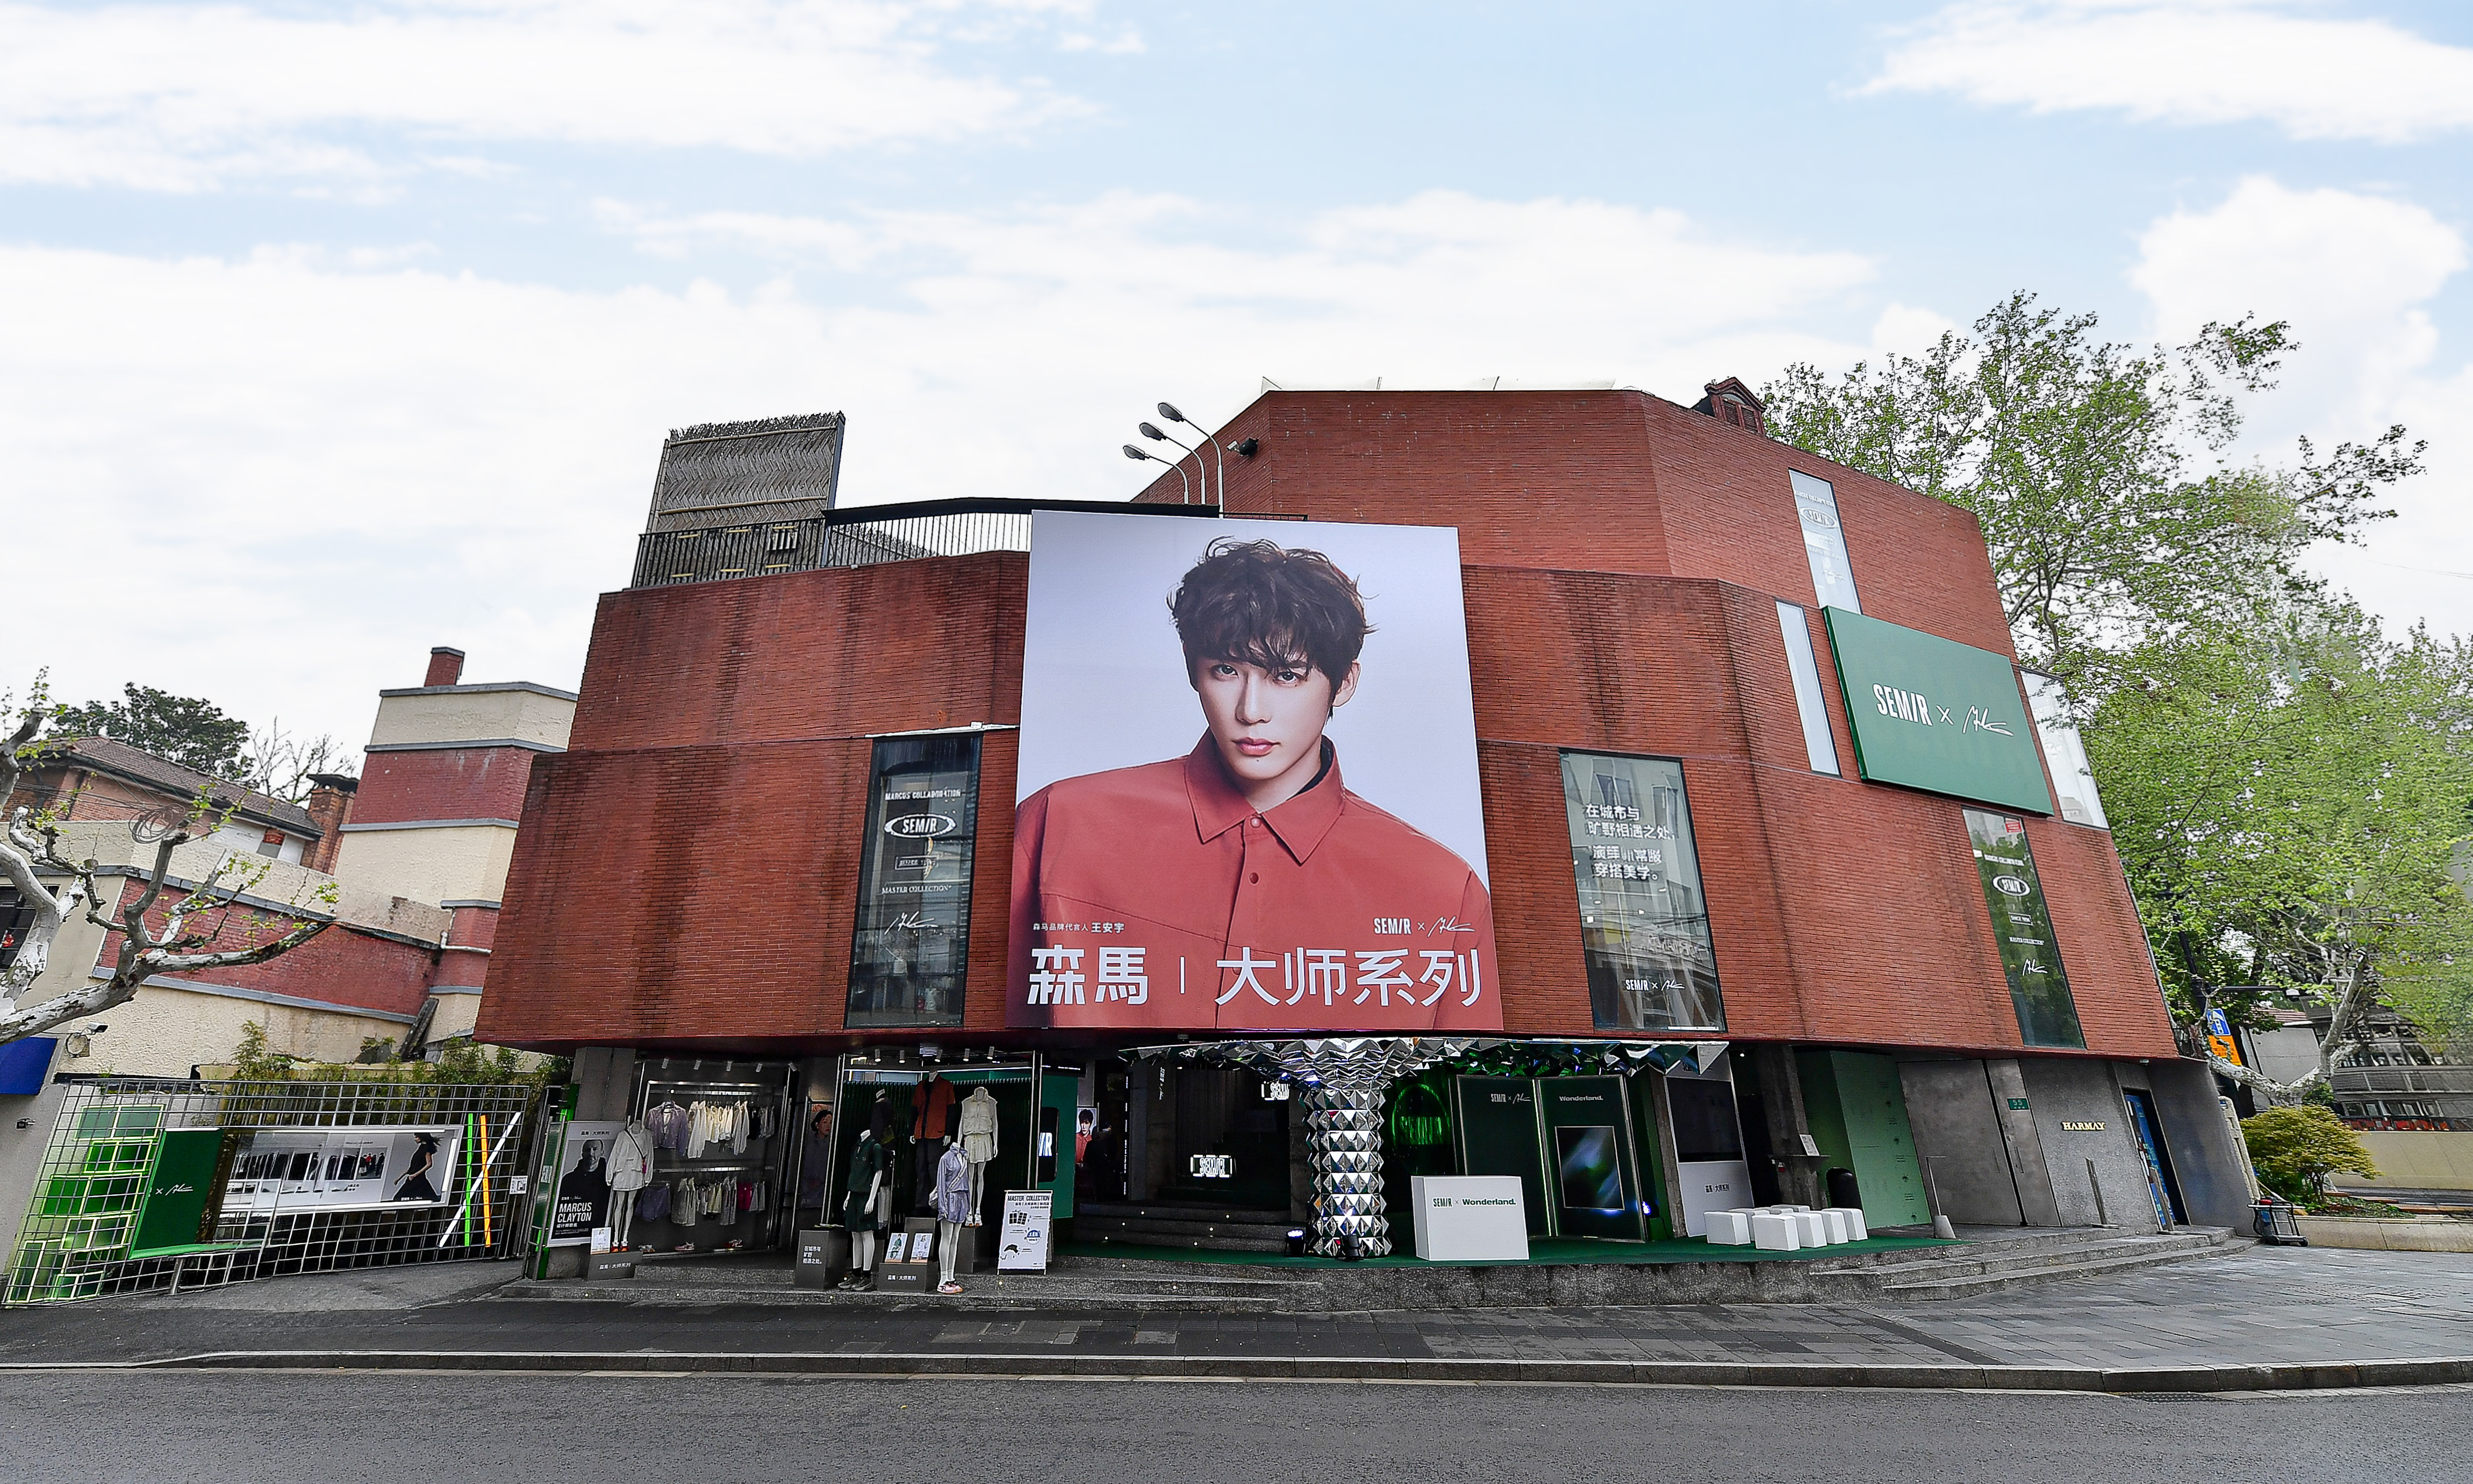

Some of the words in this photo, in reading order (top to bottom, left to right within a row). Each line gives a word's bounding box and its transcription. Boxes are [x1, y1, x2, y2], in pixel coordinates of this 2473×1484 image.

[1585, 803, 1640, 821] 在城市与
[1033, 922, 1089, 932] 森马品牌代言人
[1090, 922, 1125, 934] 王安宇
[1027, 944, 1149, 1005] 森馬
[1214, 947, 1482, 1007] 大师系列
[2062, 1121, 2106, 1130] HARMAY
[559, 1202, 592, 1213] MARCUS
[557, 1212, 592, 1223] CLAYTON
